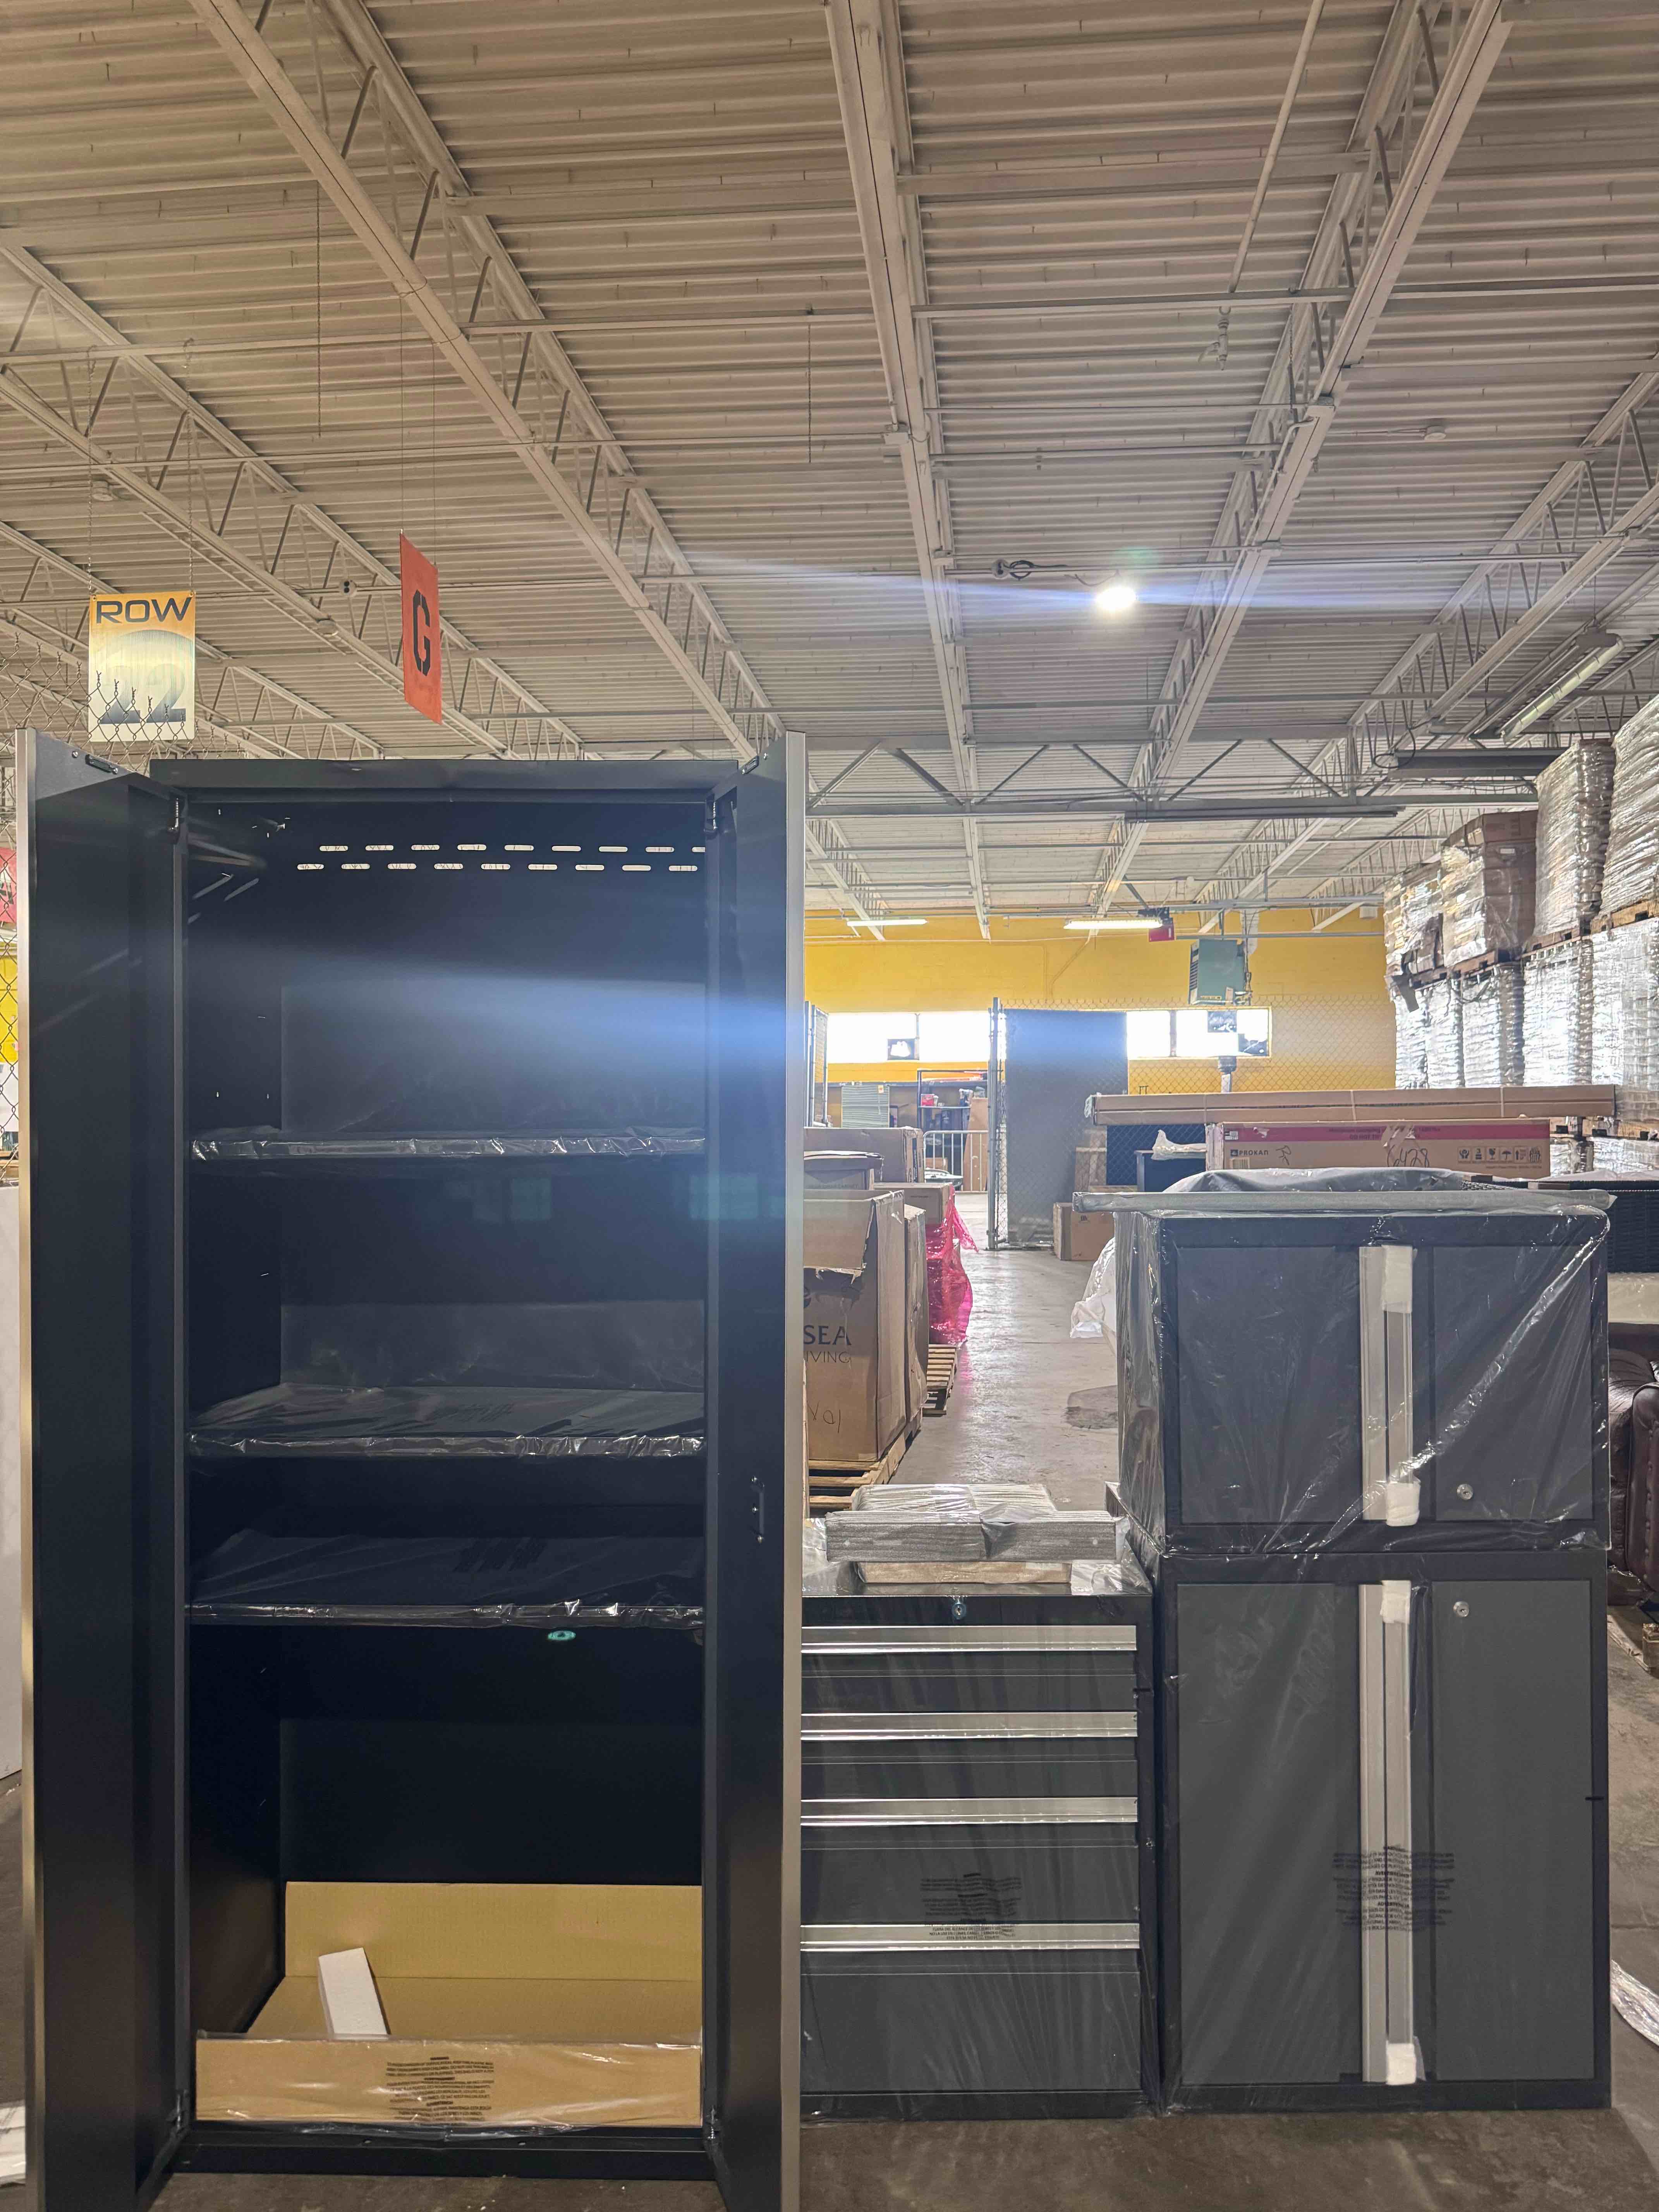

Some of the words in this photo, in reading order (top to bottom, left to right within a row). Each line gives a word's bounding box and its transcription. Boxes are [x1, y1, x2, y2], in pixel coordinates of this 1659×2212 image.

[96, 597, 192, 623] ROW
[413, 589, 430, 676] G
[806, 1351, 851, 1363] IVING
